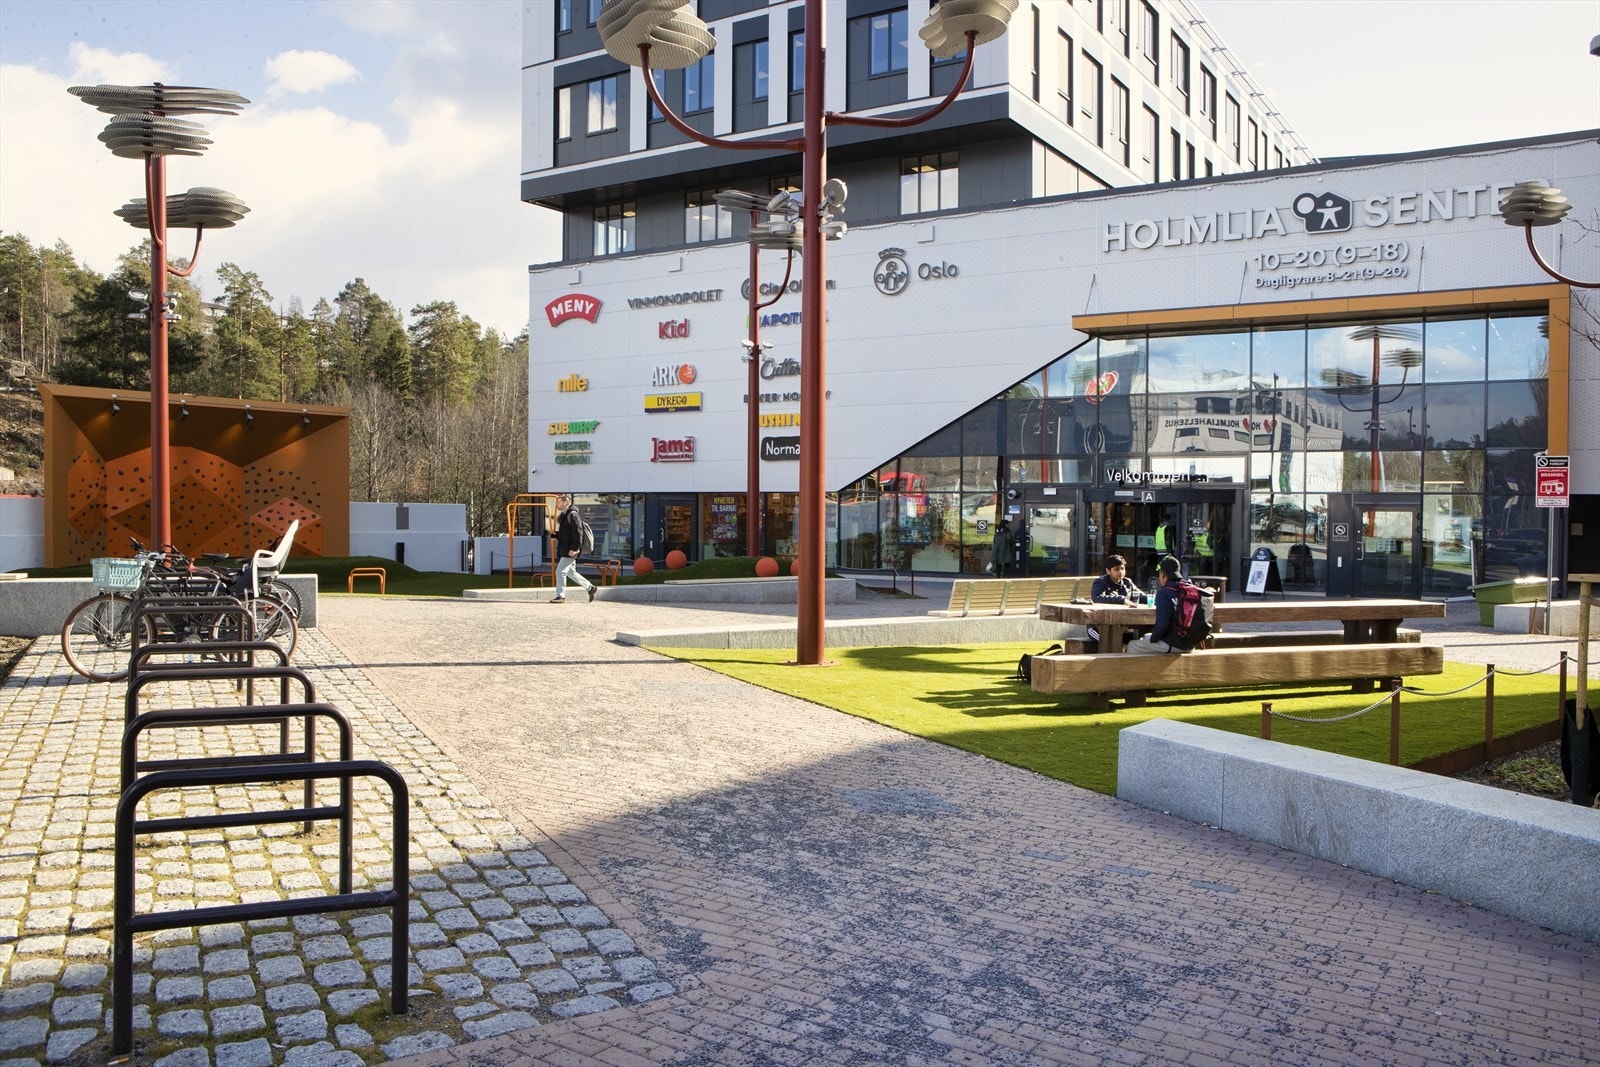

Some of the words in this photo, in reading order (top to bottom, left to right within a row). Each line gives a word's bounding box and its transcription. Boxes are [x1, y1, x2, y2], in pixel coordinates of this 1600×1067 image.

[1103, 206, 1287, 253] HOLMLIA
[1362, 178, 1550, 227] SENTE
[917, 261, 959, 280] Oslo
[627, 288, 724, 310] VINMONOPOLET
[551, 299, 595, 319] MENY
[658, 318, 690, 339] Kid
[557, 374, 589, 393] nille
[651, 364, 680, 386] ARK
[547, 420, 600, 435] SUBWAY
[758, 413, 792, 428] USHI
[650, 436, 695, 463] Jams
[765, 440, 801, 456] Norma
[1145, 492, 1154, 501] A
